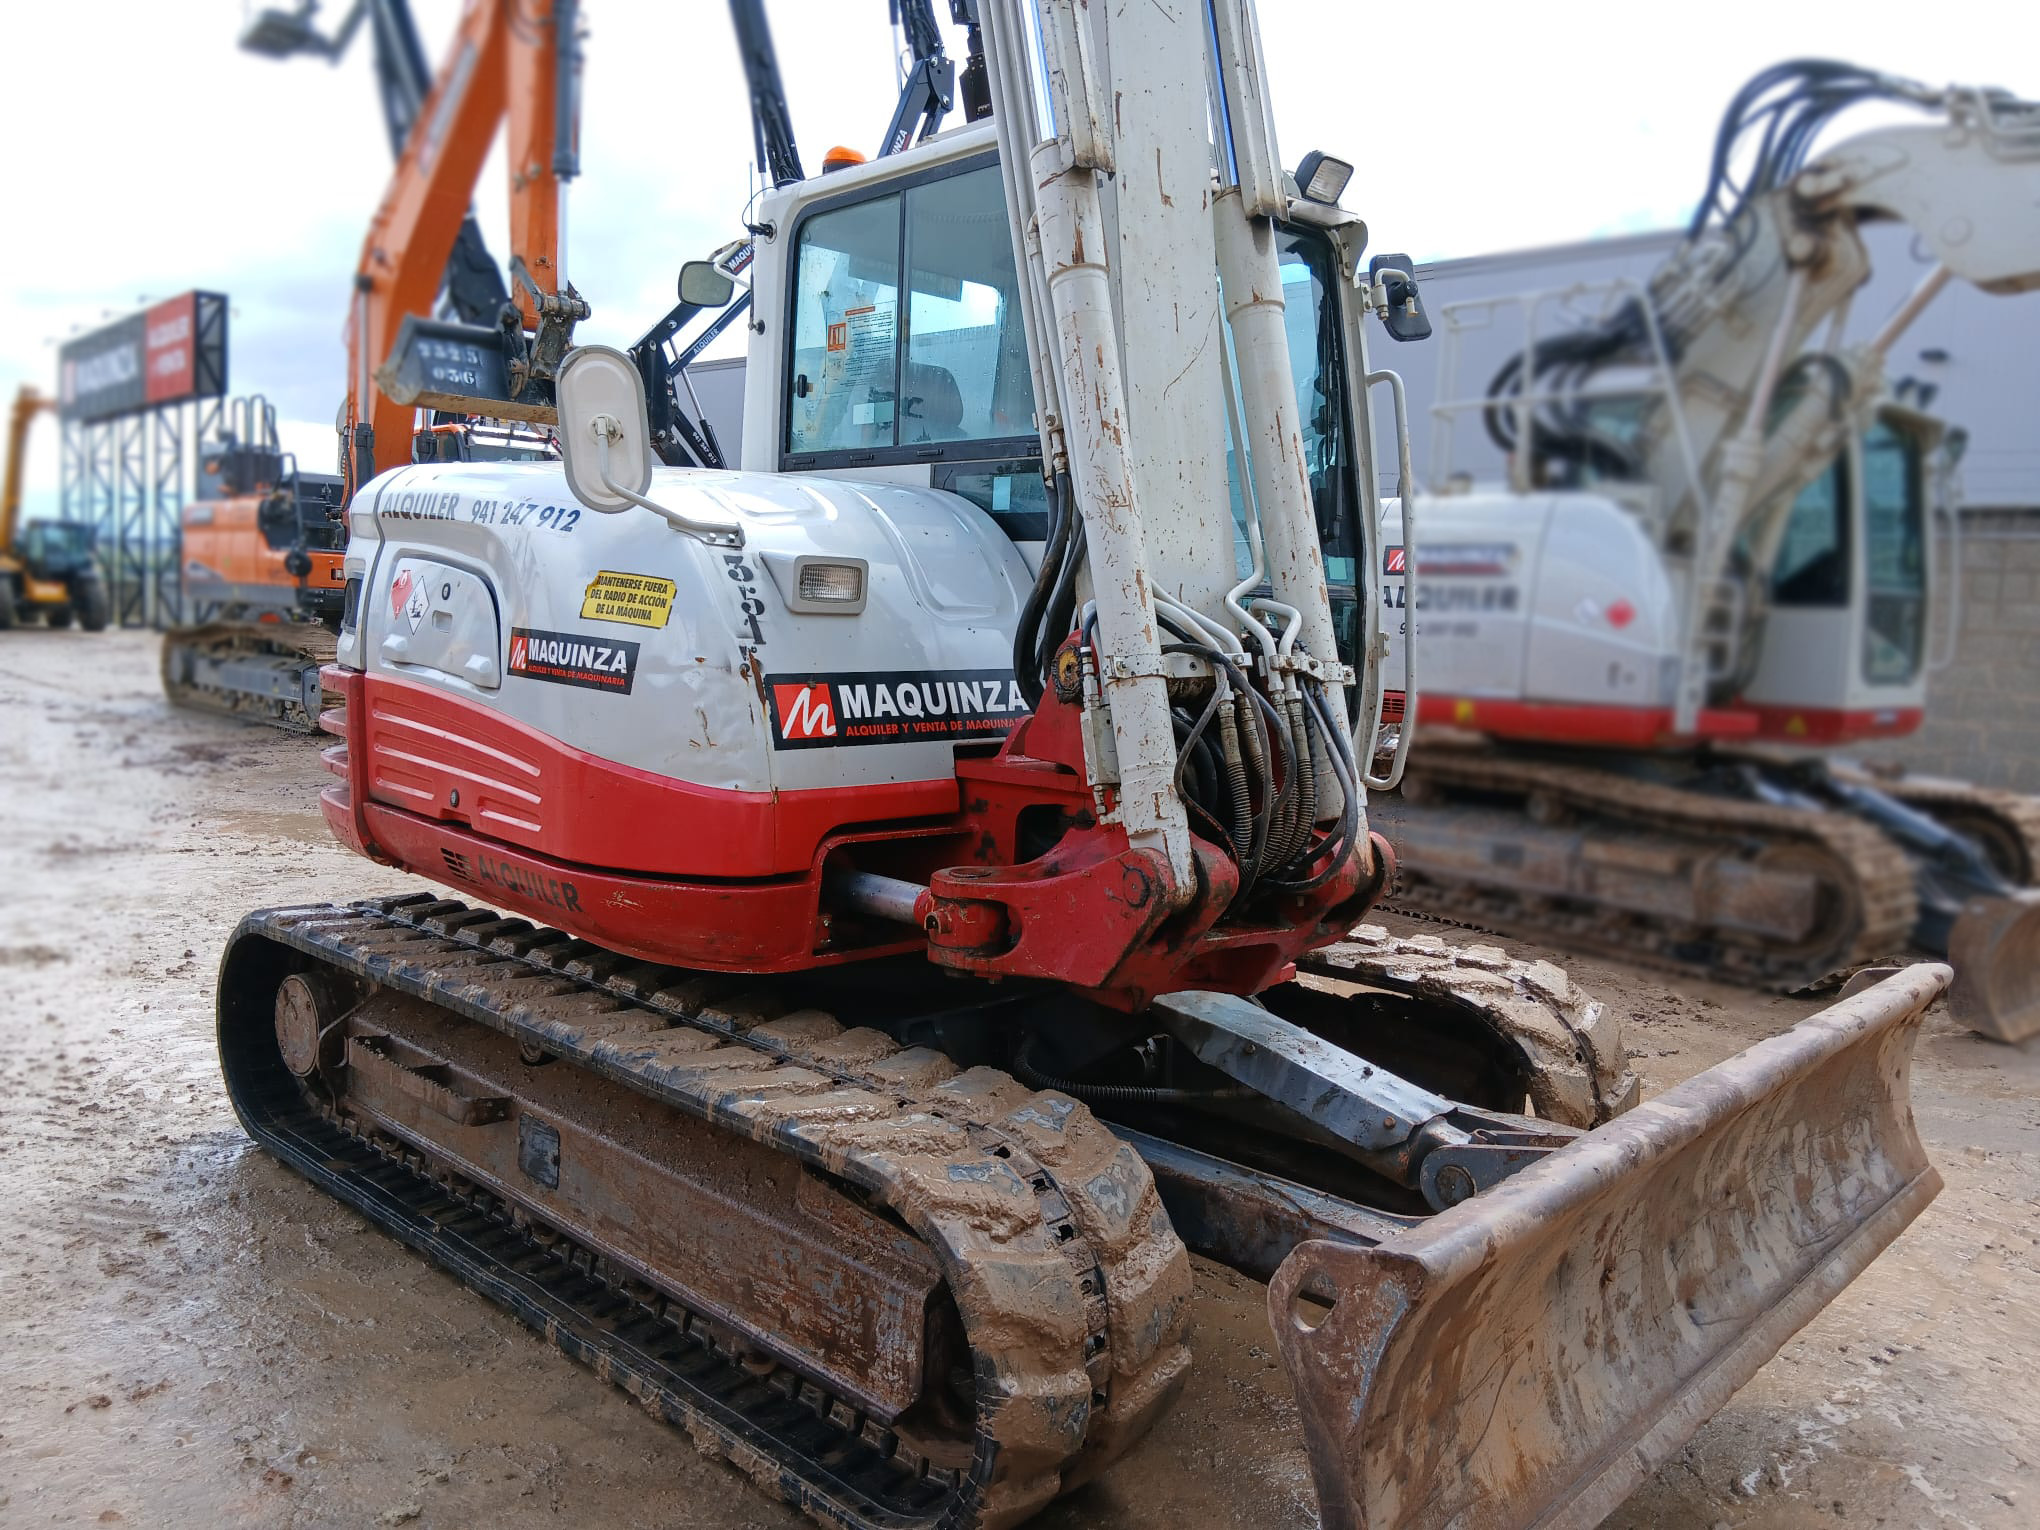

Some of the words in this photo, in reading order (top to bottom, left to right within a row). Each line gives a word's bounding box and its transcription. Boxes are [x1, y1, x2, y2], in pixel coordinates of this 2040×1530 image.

[381, 493, 460, 521] ALQUILER
[472, 500, 498, 524] 941
[501, 501, 535, 525] 247
[536, 506, 581, 532] 912
[597, 575, 642, 590] MANTENERSE
[643, 581, 668, 594] FUERA
[591, 589, 602, 599] DEL
[603, 590, 626, 602] RADIO
[627, 593, 636, 604] DE
[595, 603, 604, 613] DE
[606, 605, 615, 615] LA
[528, 638, 627, 674] MAQUINZA
[567, 670, 576, 679] DE
[576, 671, 625, 686] MAQUINARIA
[837, 680, 1031, 719] MAQUINZA
[846, 724, 898, 737] ALQUILER
[902, 724, 909, 733] Y
[914, 720, 948, 733] VENTA
[950, 720, 963, 731] DE
[478, 855, 584, 912] ALQUILER
